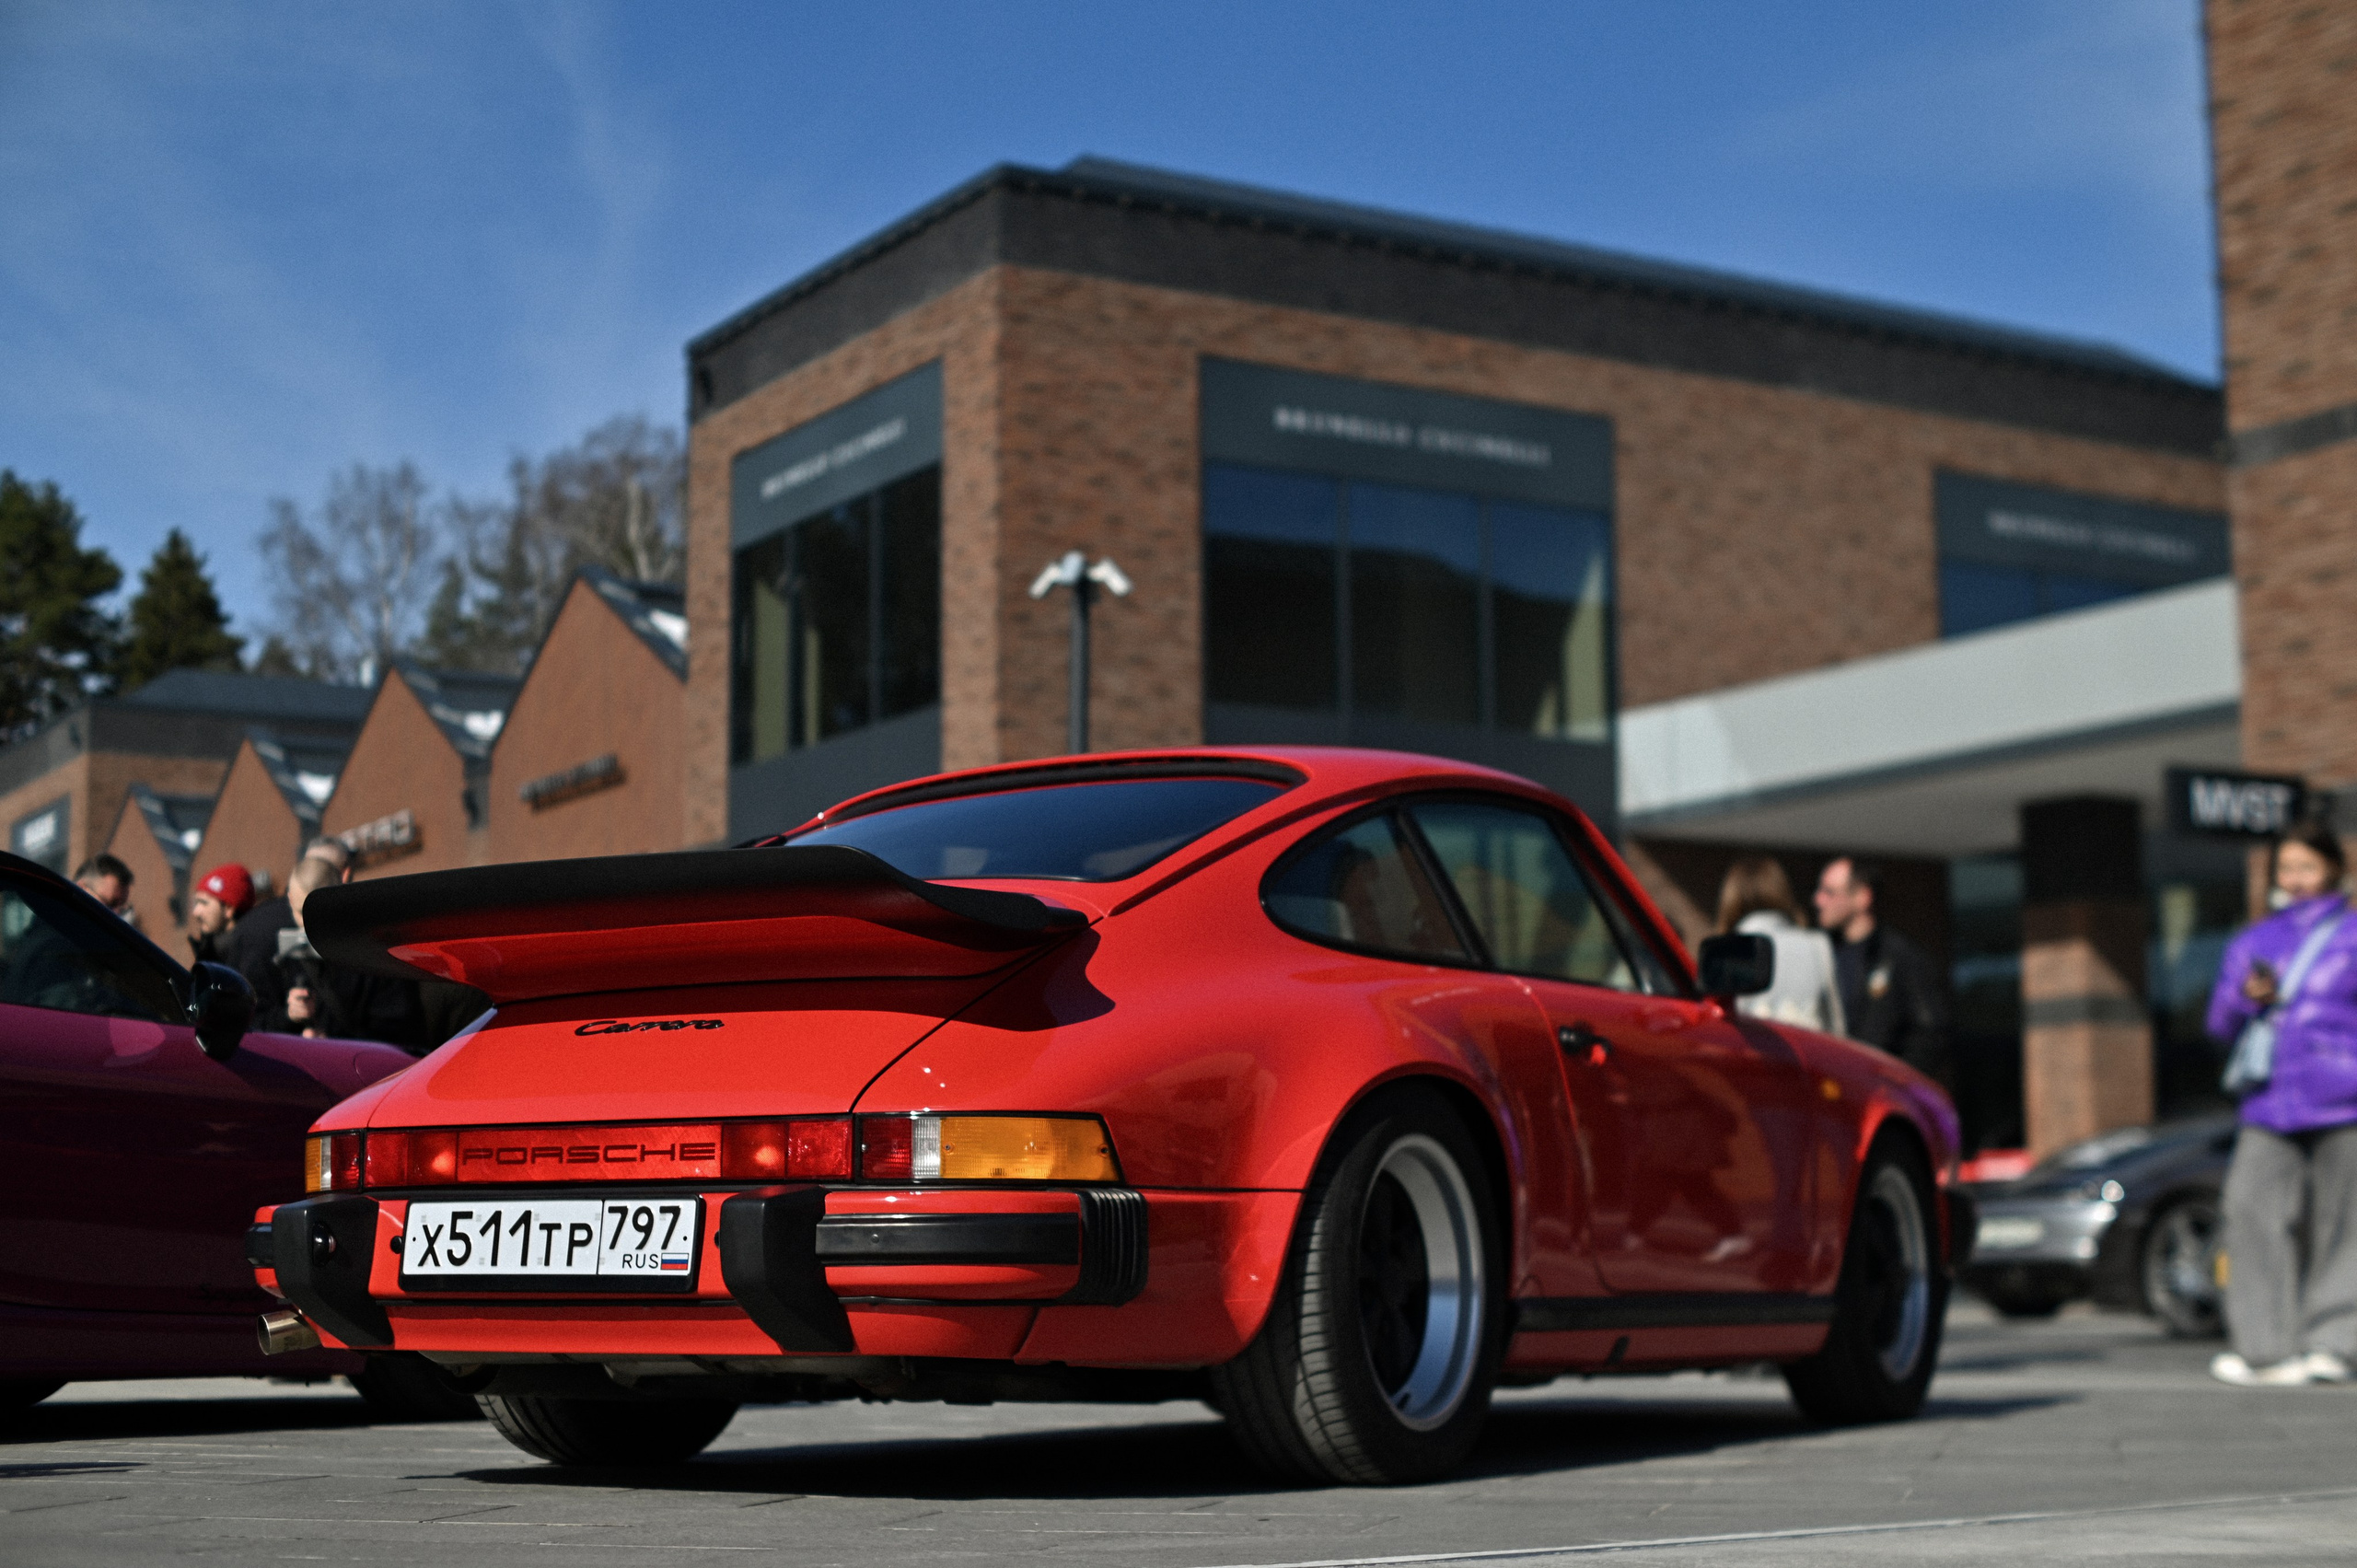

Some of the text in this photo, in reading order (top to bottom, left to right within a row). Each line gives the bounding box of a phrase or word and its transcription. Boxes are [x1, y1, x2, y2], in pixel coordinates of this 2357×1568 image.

[574, 1019, 726, 1037] Carrera
[462, 1142, 716, 1166] PORSCHE
[608, 1205, 681, 1250] 797
[621, 1253, 659, 1270] RUS
